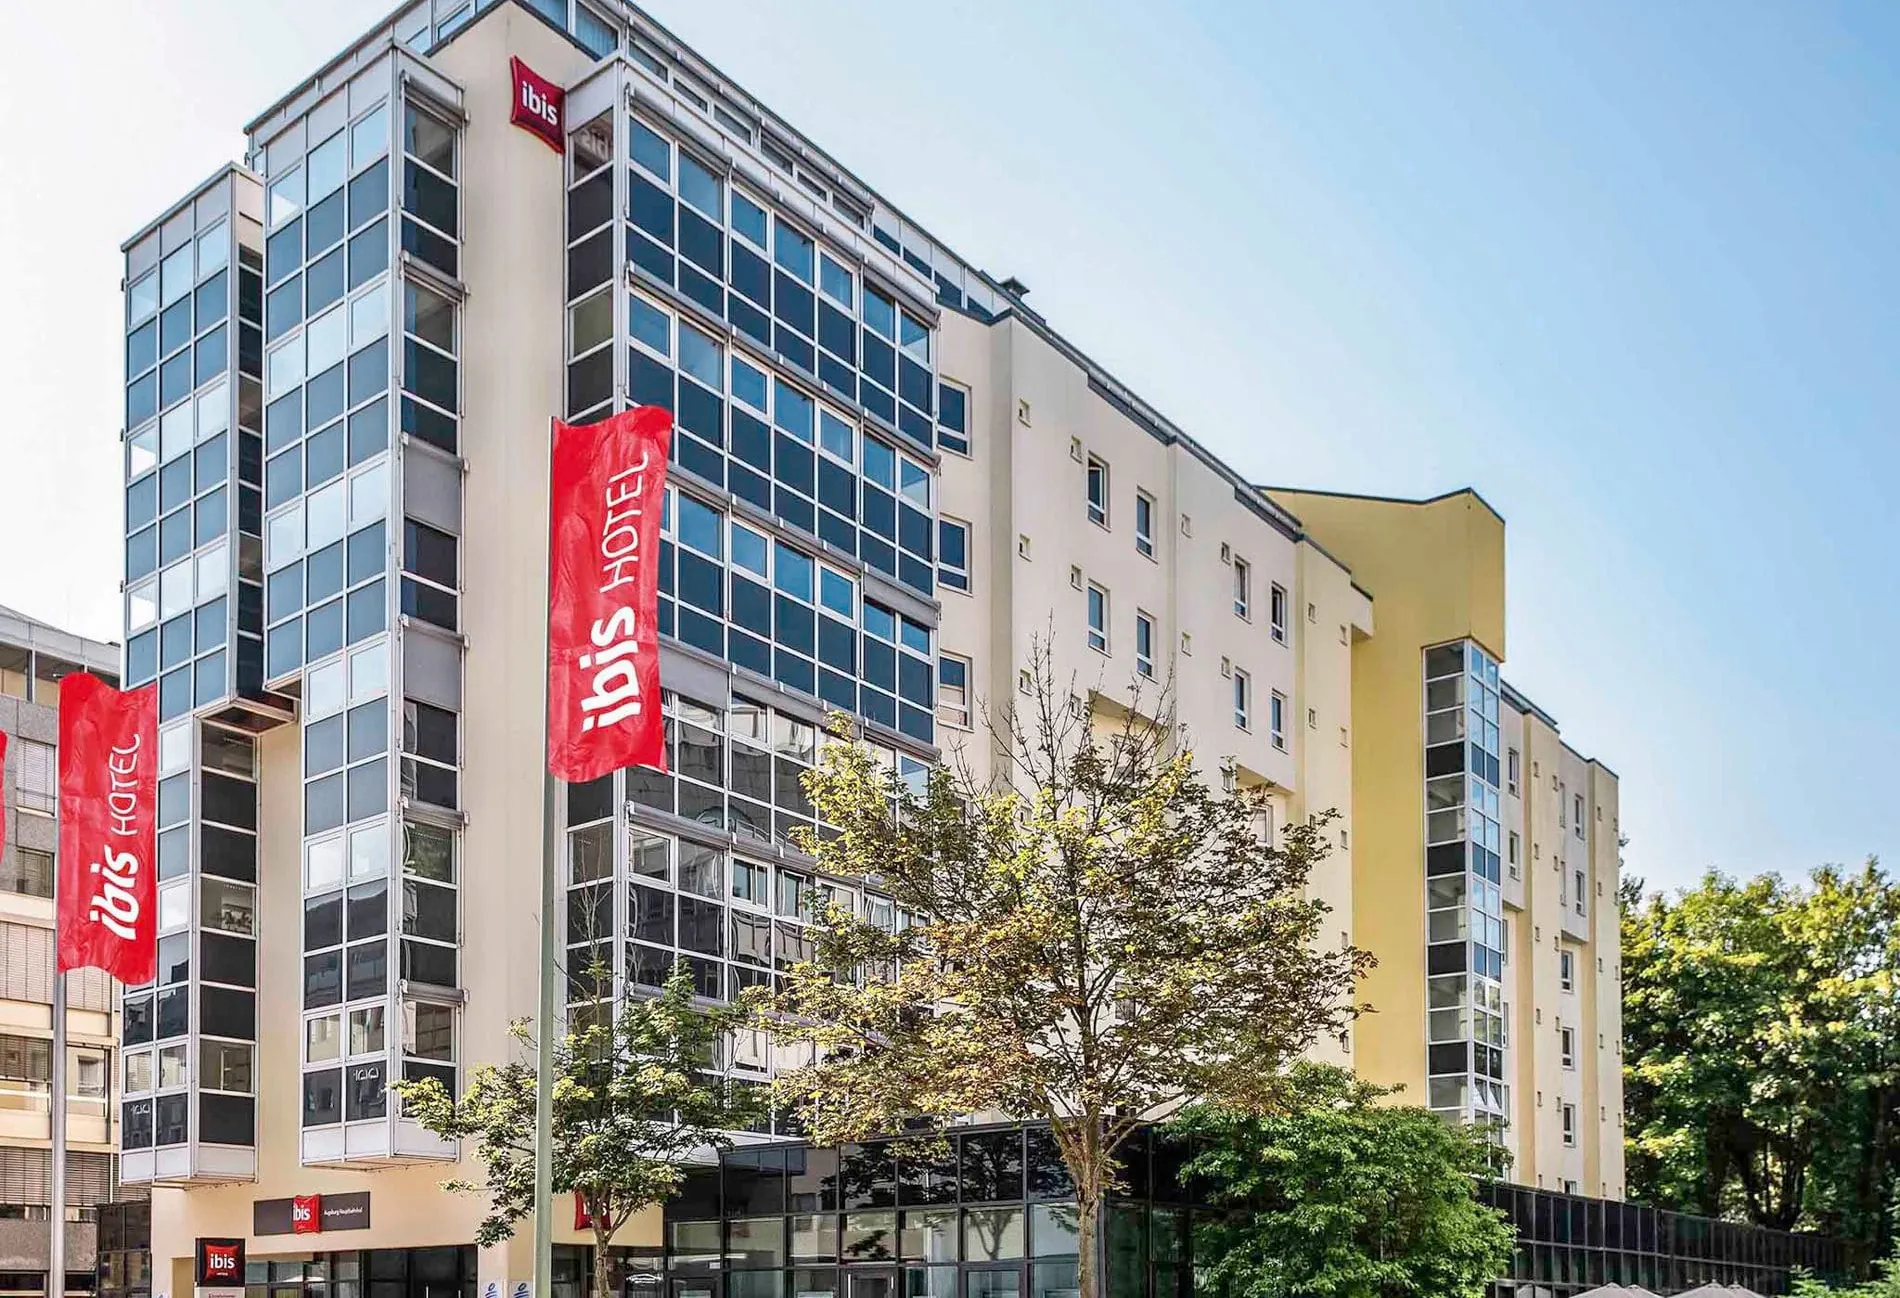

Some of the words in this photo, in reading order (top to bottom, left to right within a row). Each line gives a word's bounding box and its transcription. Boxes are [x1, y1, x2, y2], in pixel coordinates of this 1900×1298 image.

[522, 80, 558, 126] ibis
[600, 450, 649, 594] HOTEL
[578, 604, 641, 734] ibis
[108, 733, 142, 836] HOTEL
[89, 844, 141, 941] ibis
[292, 1202, 311, 1221] ibis
[210, 1253, 236, 1269] ibis
